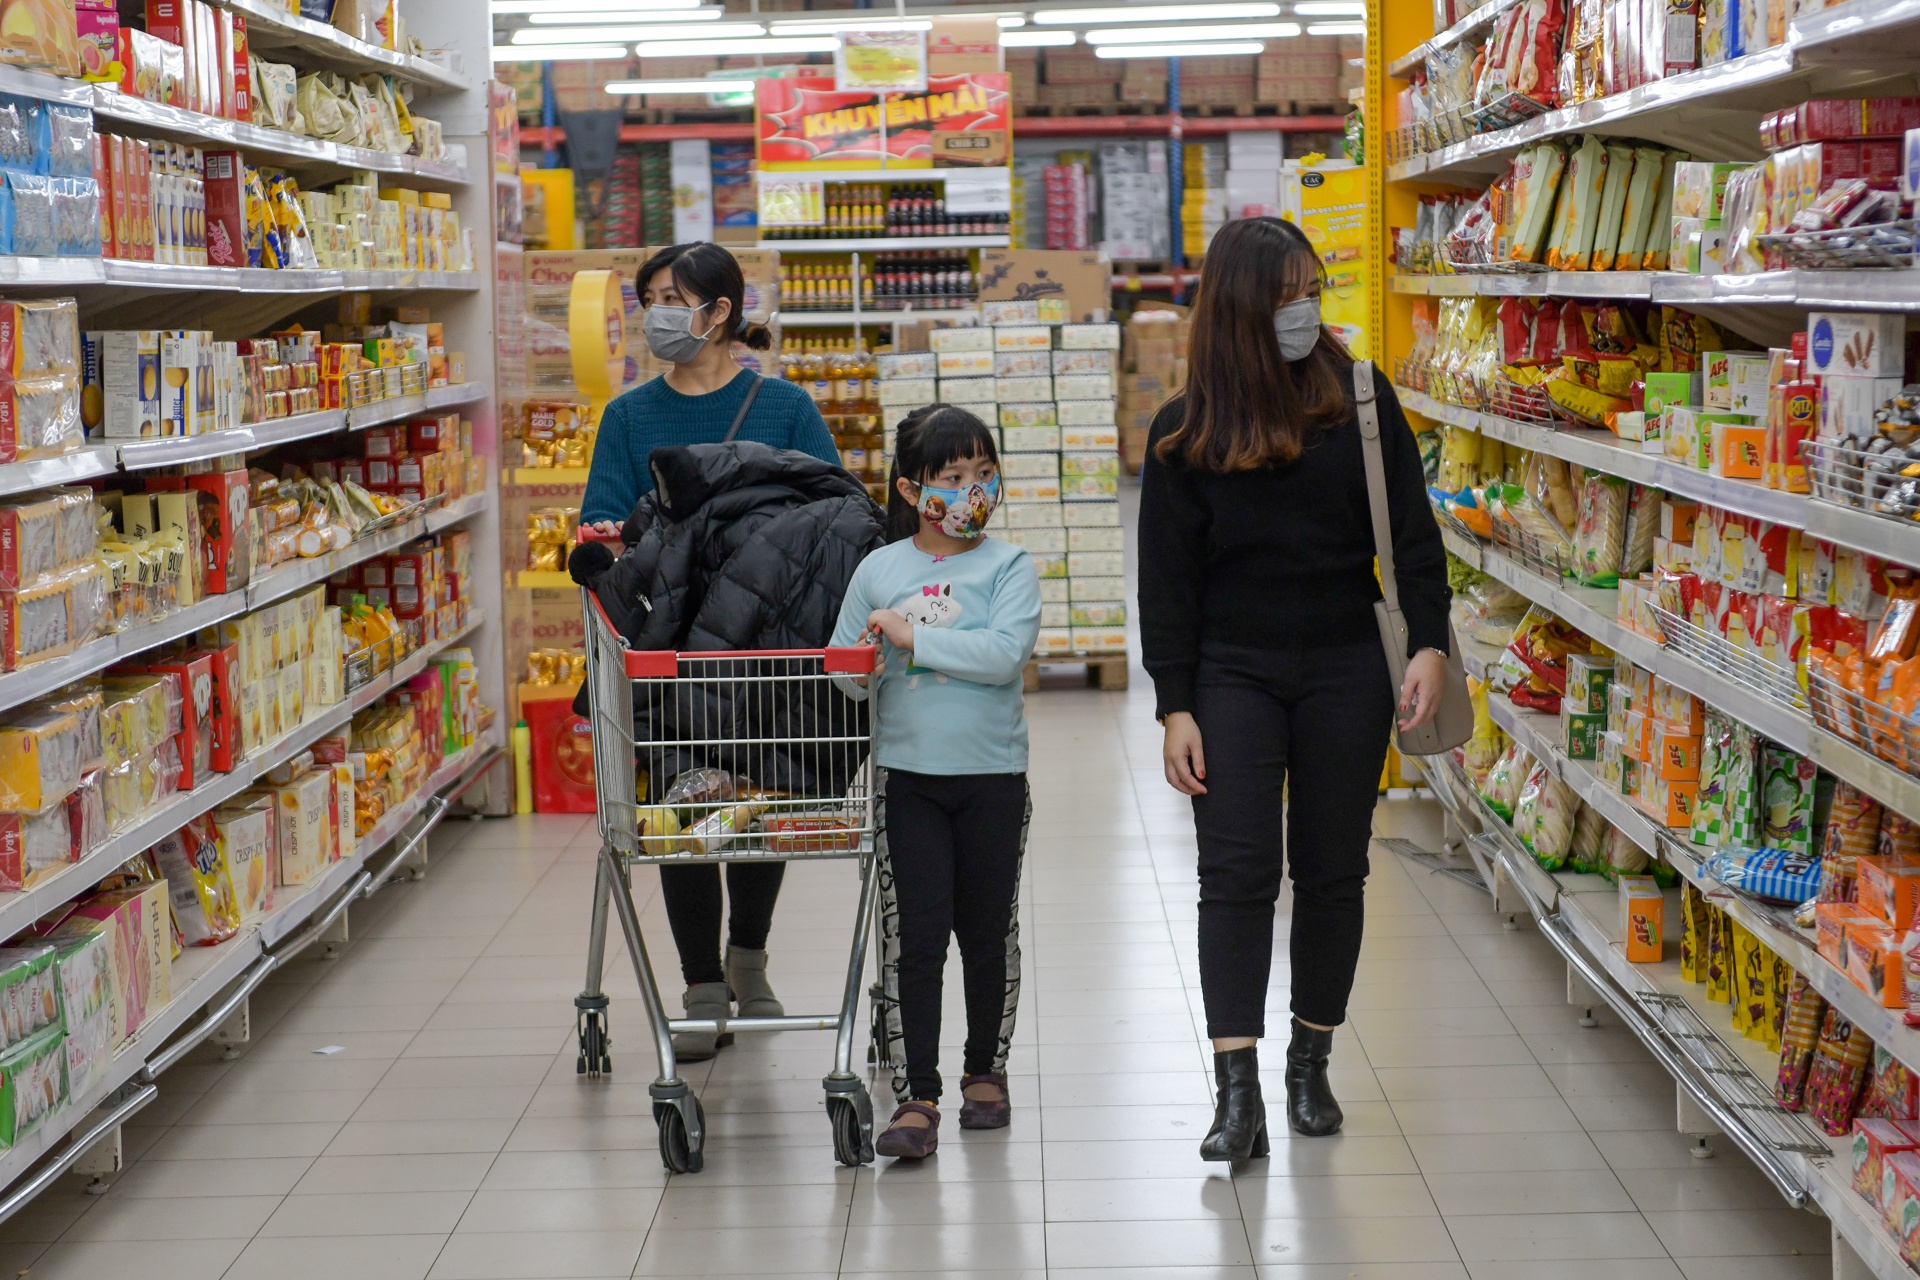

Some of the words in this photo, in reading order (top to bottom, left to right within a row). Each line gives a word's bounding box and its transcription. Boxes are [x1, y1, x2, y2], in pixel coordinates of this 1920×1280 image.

[803, 93, 926, 138] KHUYẾN
[86, 341, 96, 382] Butter
[531, 412, 555, 420] MARIE
[531, 419, 555, 427] GOLD
[573, 723, 591, 734] COS
[1668, 744, 1683, 769] AFC
[1675, 791, 1691, 815] AFC
[5, 830, 17, 855] HURA
[290, 815, 298, 855] CRISPY-JOY
[234, 841, 264, 865] CRISPY-JOY
[151, 899, 162, 967] HURA
[1632, 914, 1653, 947] AFC
